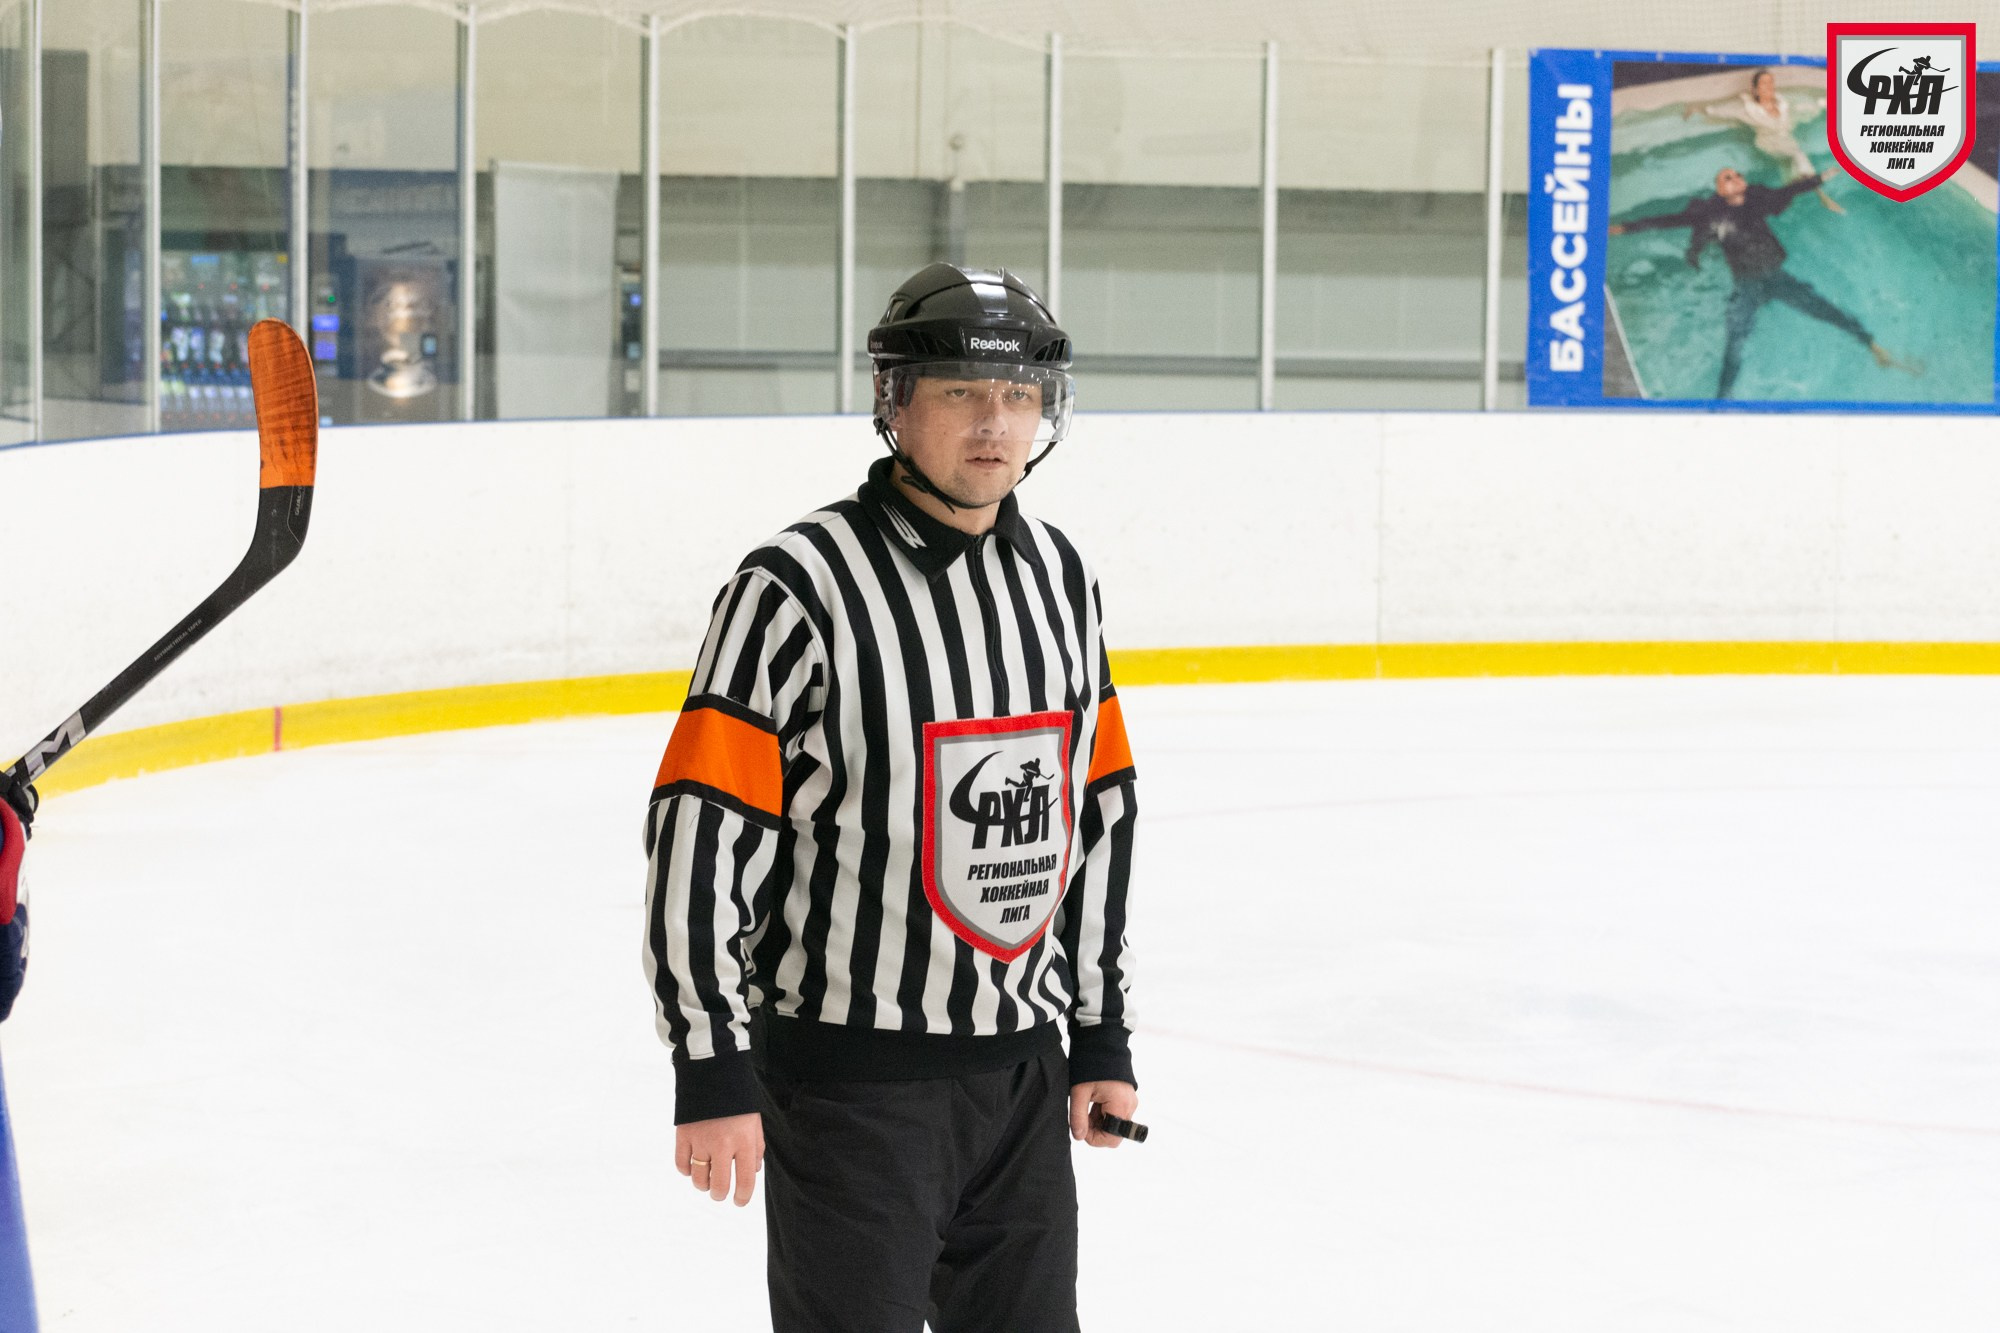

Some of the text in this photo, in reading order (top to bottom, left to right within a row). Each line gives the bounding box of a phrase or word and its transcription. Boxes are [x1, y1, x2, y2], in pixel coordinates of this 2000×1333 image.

[1545, 84, 1592, 372] БАССЕЙНЫ
[970, 337, 1020, 352] Reebok
[971, 784, 1050, 850] РХЛ
[967, 853, 1057, 880] РЕГИОНАЛЬНАЯ
[980, 878, 1049, 903] ХОККЕЙНАЯ
[999, 905, 1031, 924] ЛИГА
